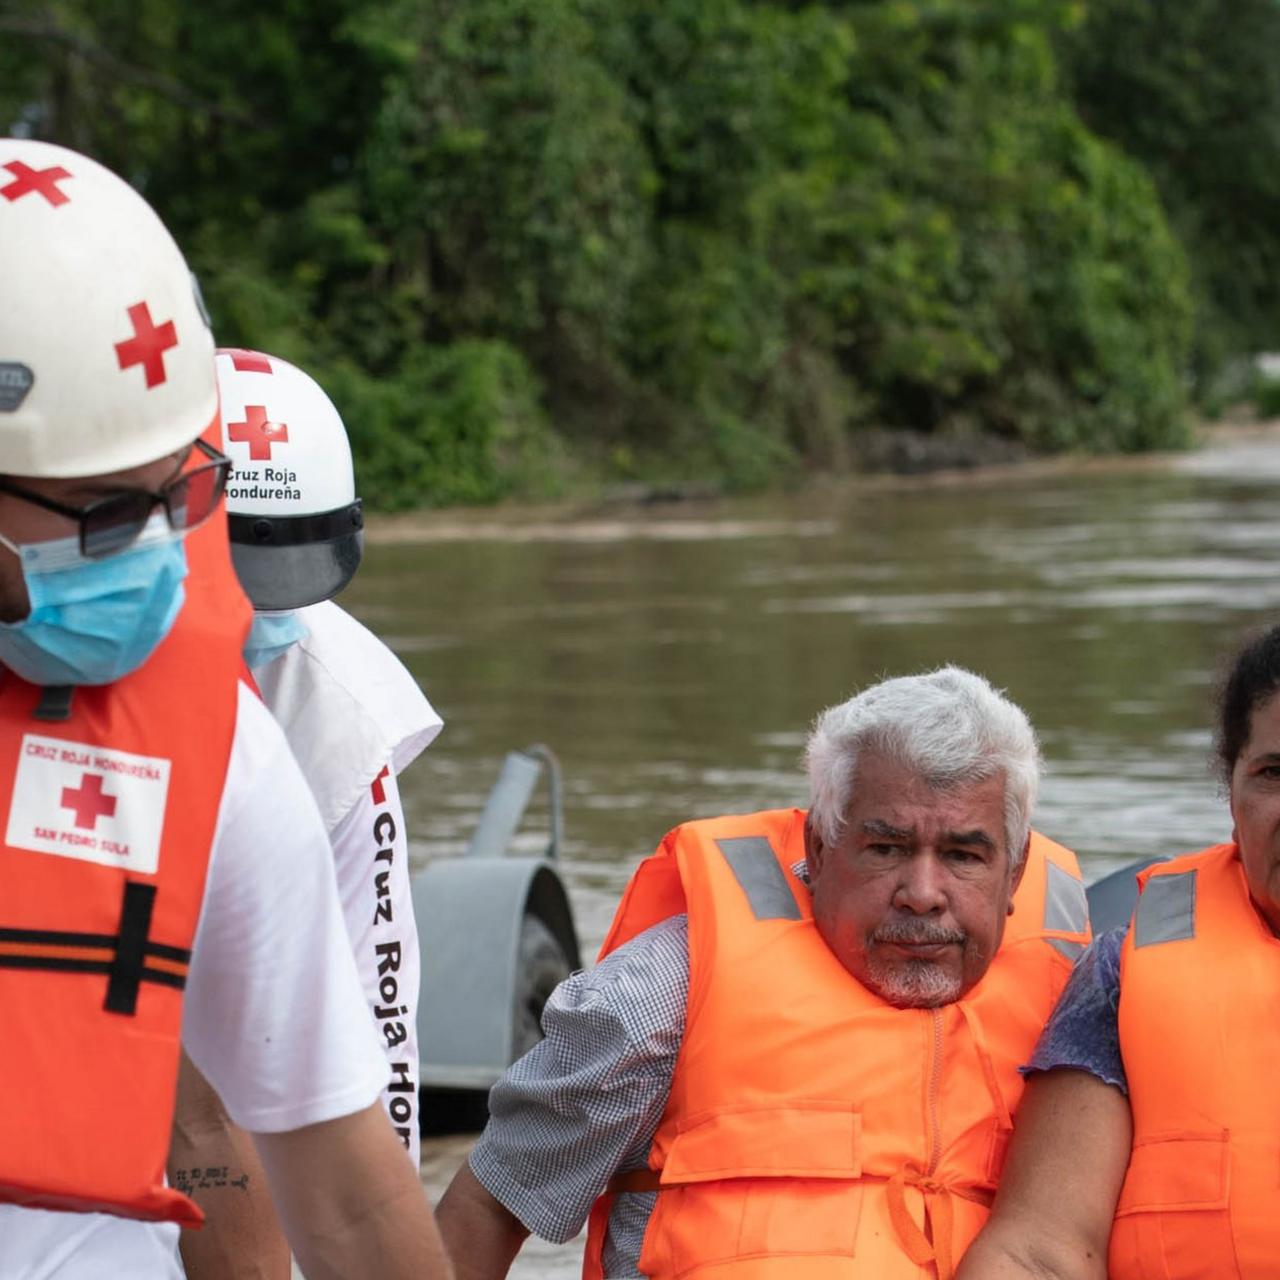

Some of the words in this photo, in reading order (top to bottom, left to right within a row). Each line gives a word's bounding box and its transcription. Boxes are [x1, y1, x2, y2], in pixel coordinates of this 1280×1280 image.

[265, 467, 297, 485] Roja
[26, 743, 58, 761] CRUZ
[61, 750, 90, 766] ROJA
[94, 756, 161, 780] HONDUREÑA
[34, 826, 58, 841] SAN
[61, 831, 97, 848] PEDRO
[101, 839, 130, 856] SULA
[373, 811, 397, 926] Cruz
[374, 941, 408, 1048] Roja
